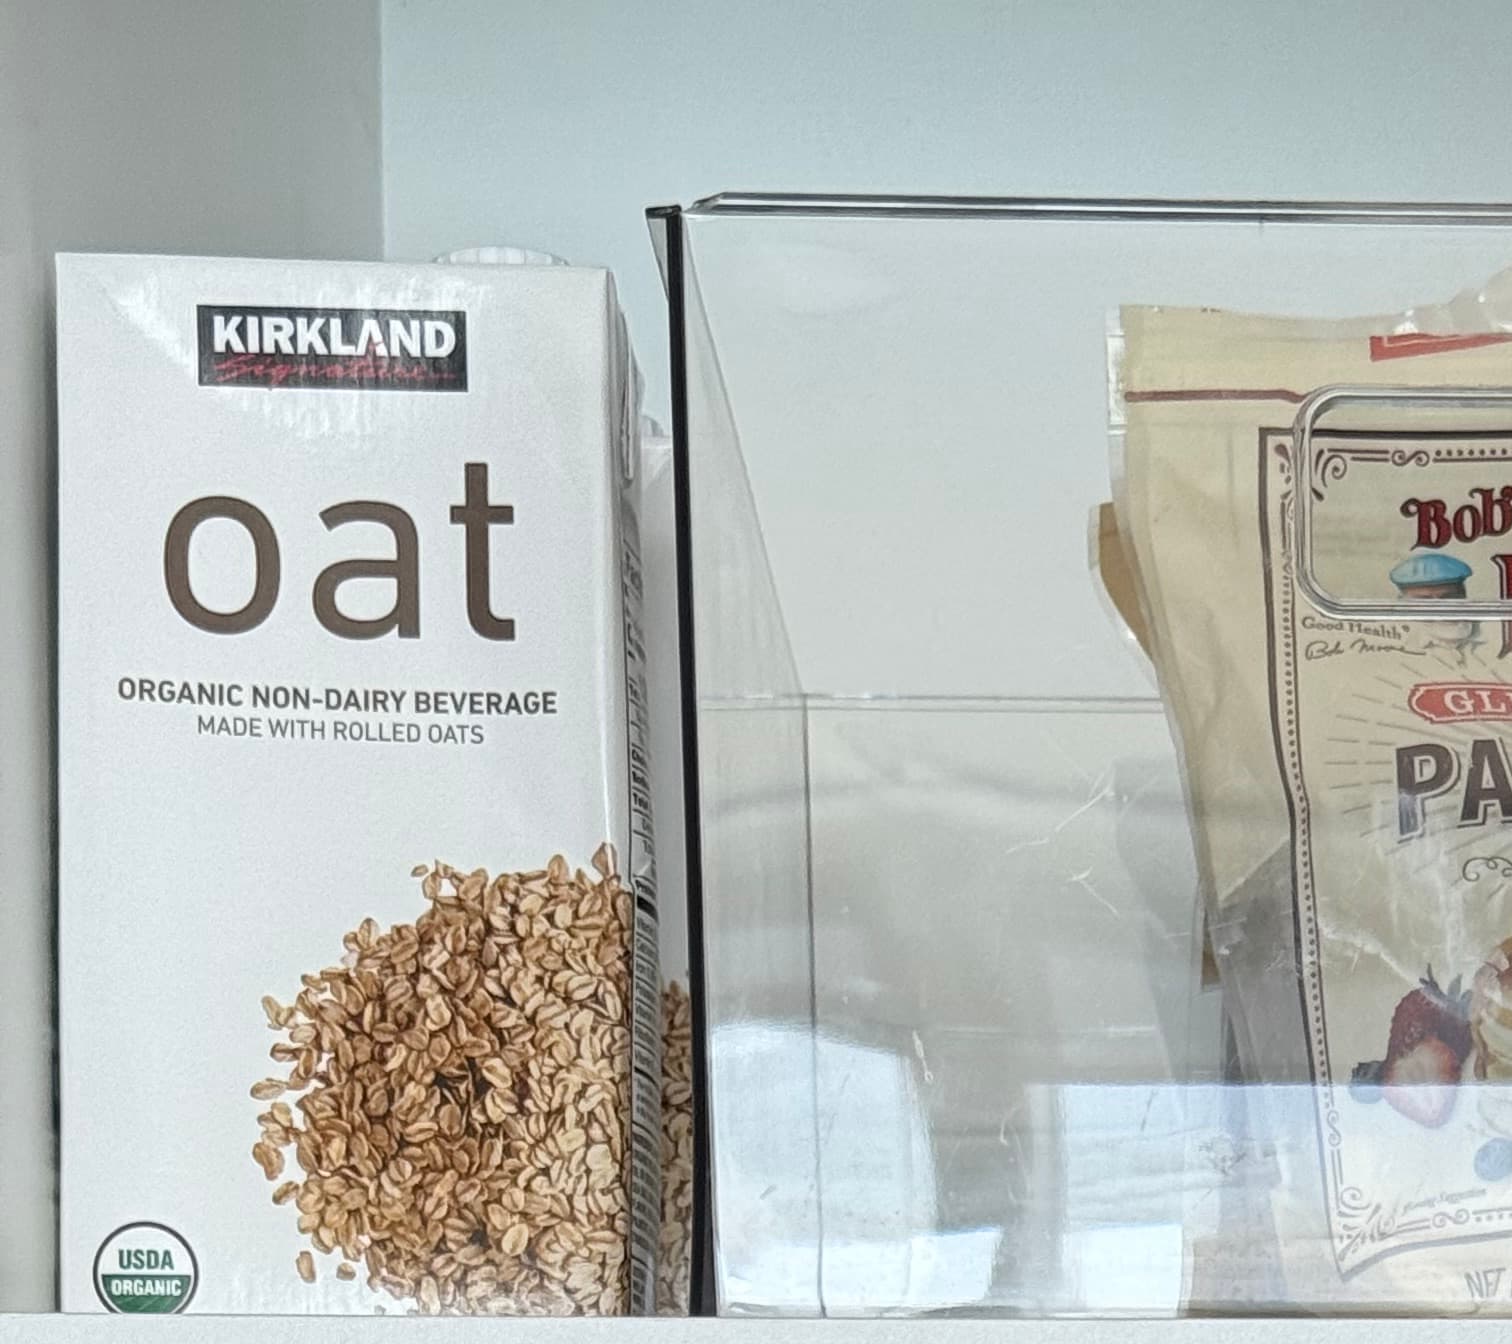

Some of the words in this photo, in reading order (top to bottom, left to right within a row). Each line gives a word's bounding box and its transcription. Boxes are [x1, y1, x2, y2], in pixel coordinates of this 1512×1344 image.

[212, 315, 456, 358] KIRKLAND
[163, 463, 516, 641] oat
[1301, 615, 1344, 633] Good
[117, 676, 244, 708] ORGANIC
[251, 684, 407, 714] NON-DAIRY
[414, 690, 558, 716] BEVERAGE
[197, 714, 263, 738] MADE
[268, 719, 326, 741] WITH
[333, 721, 422, 743] ROLLED
[428, 724, 485, 745] OATS
[118, 1248, 174, 1270] USDA
[111, 1279, 181, 1297] ORGANIC
[1464, 1267, 1506, 1300] NET
